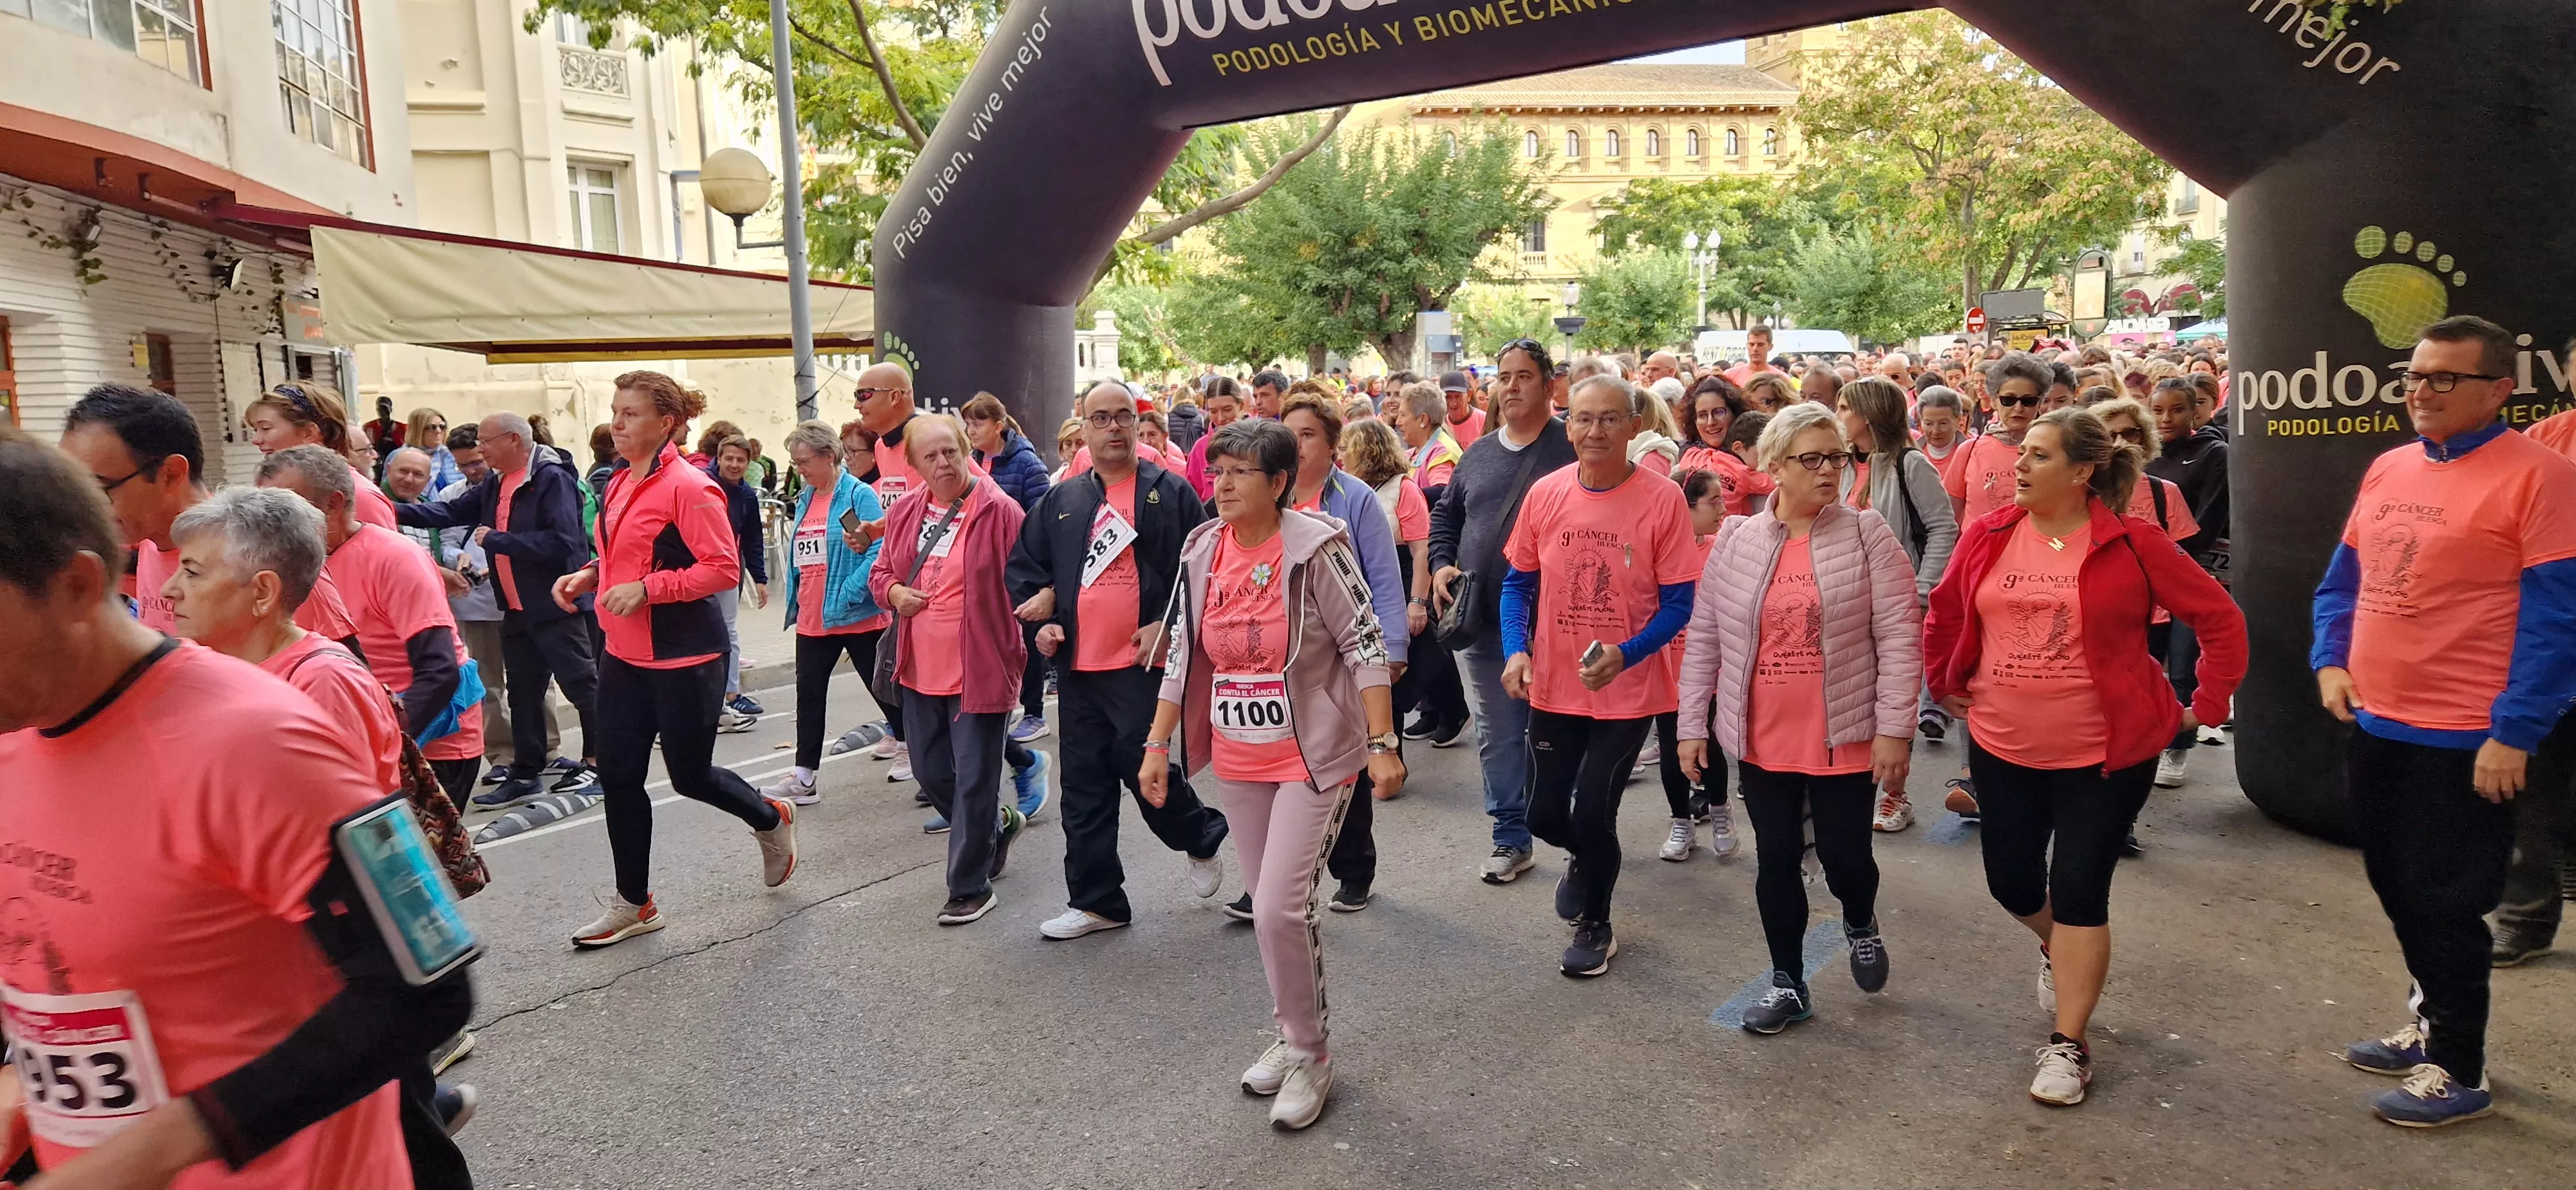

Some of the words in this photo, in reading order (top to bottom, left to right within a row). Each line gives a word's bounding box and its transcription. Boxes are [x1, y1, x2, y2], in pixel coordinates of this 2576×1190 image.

[1211, 23, 1381, 76] PODOLOGÍA
[1383, 23, 1405, 46] Y
[893, 206, 933, 258] Pisa
[926, 150, 974, 206] bien,
[967, 91, 1004, 142] vive
[1001, 6, 1052, 92] mejor
[2268, 409, 2401, 437] PODOLOGÍA
[798, 540, 819, 556] 951
[1086, 528, 1118, 569] 583
[1577, 528, 1618, 542] CÁNCER
[1597, 540, 1625, 550] HUESCA
[1332, 551, 1352, 578] PUMA
[1250, 688, 1281, 697] CÁNCER
[1217, 700, 1285, 727] 1100
